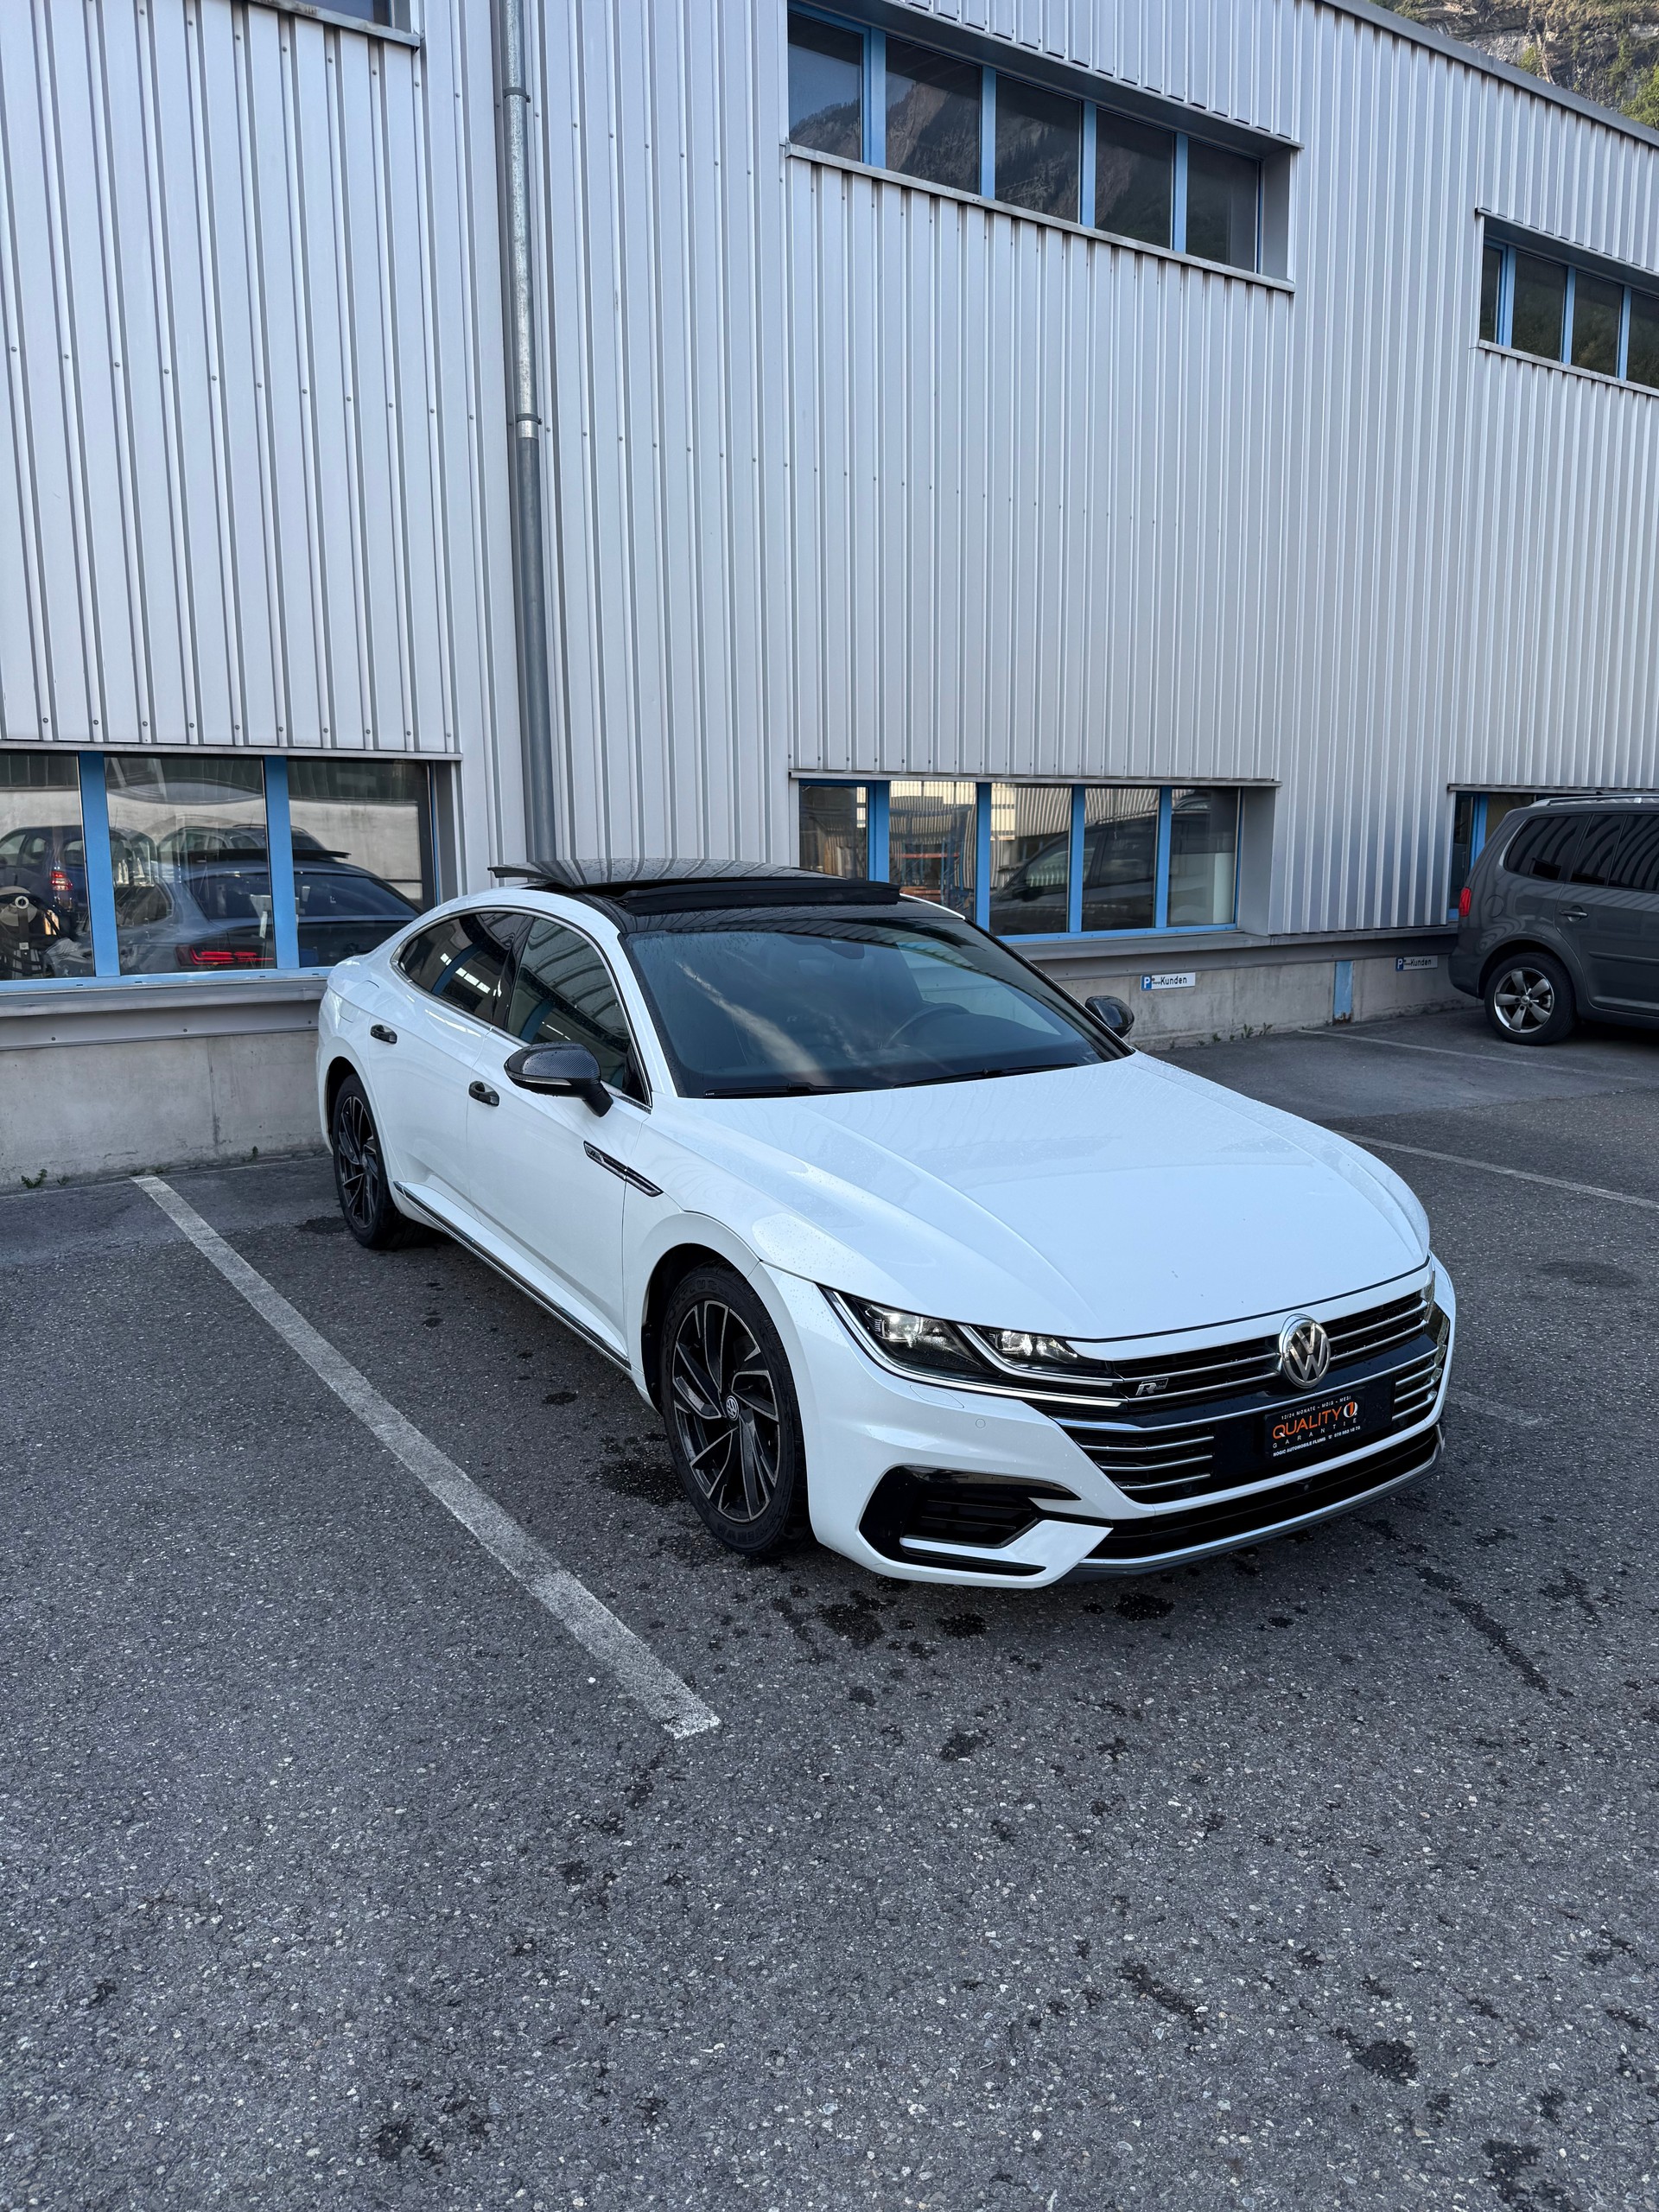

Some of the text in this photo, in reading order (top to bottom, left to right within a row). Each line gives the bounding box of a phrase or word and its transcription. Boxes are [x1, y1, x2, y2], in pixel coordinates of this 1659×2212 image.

[1410, 957, 1432, 967] Kunden
[1143, 976, 1187, 988] P Kunden
[1296, 1406, 1316, 1415] MONATE
[1272, 1405, 1343, 1440] QUALITY
[1272, 1417, 1357, 1449] GARANTIE
[1287, 1440, 1313, 1452] AUTOMOBILE
